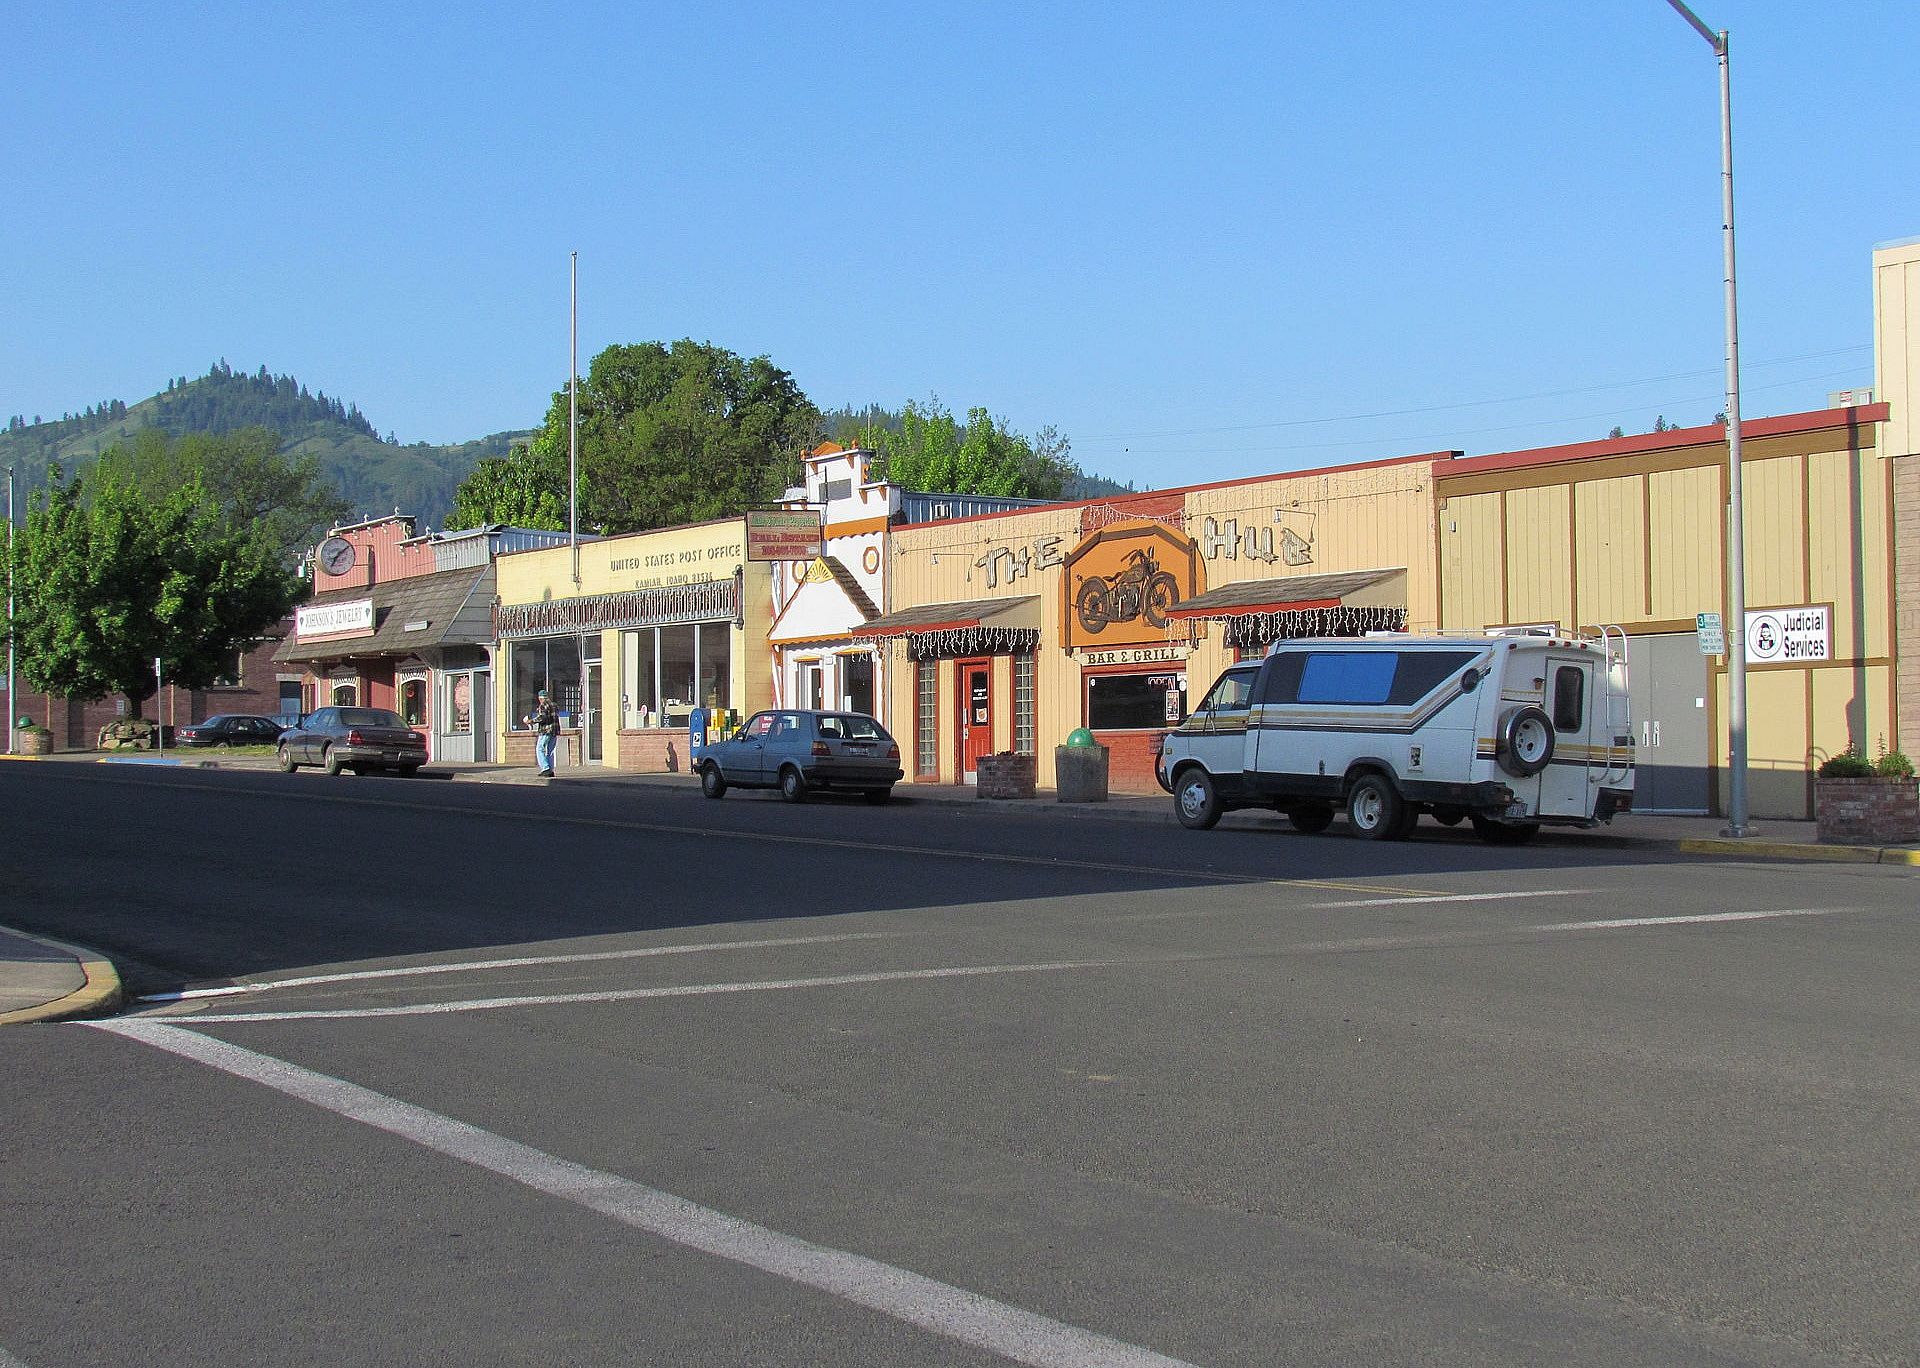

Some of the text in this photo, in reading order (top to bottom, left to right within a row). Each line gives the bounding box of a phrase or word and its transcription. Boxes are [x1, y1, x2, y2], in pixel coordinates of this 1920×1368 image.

[610, 544, 741, 572] UNITED STATES POST OFFICE
[975, 537, 1063, 589] THE
[666, 574, 689, 586] IDAHO
[336, 606, 363, 625] JEWELRY
[1784, 611, 1824, 632] Judicial
[1087, 651, 1116, 665] BAR
[1133, 648, 1179, 661] GRILL
[1784, 635, 1825, 658] Services
